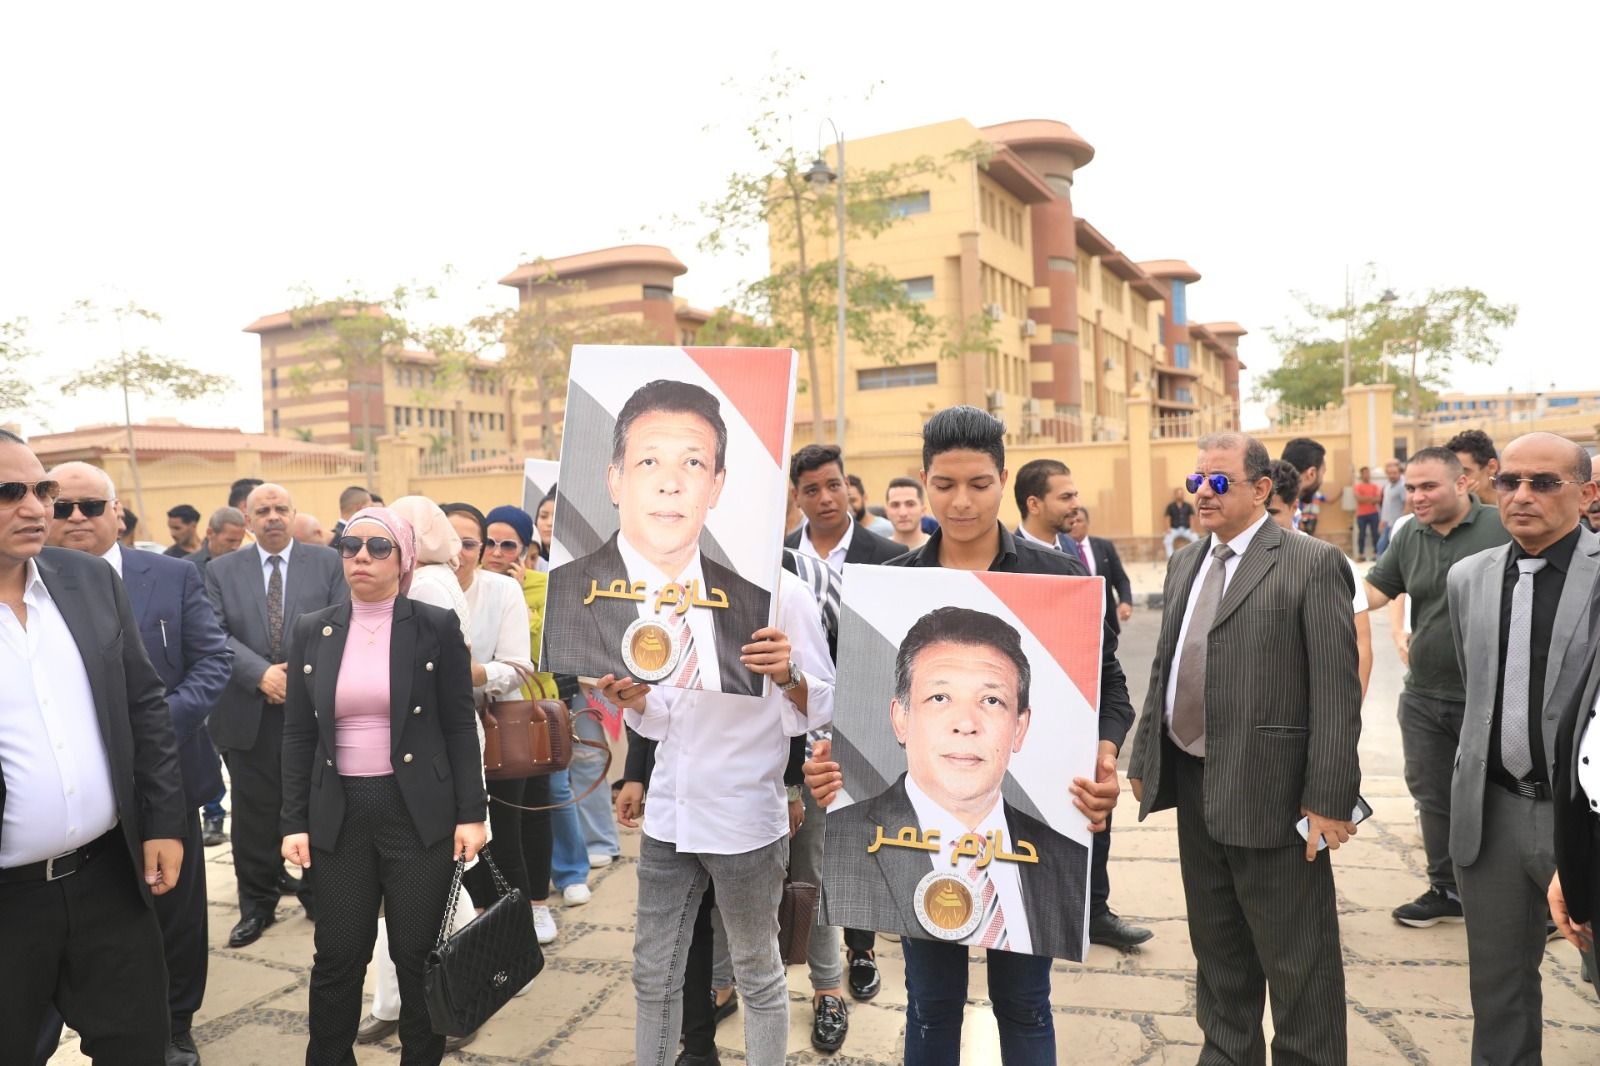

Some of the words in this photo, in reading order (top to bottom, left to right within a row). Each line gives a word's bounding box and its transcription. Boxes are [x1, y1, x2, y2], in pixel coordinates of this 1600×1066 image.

[584, 579, 646, 605] عمر
[655, 578, 729, 614] حازم
[867, 825, 941, 853] عمر
[951, 829, 1039, 868] حازم
